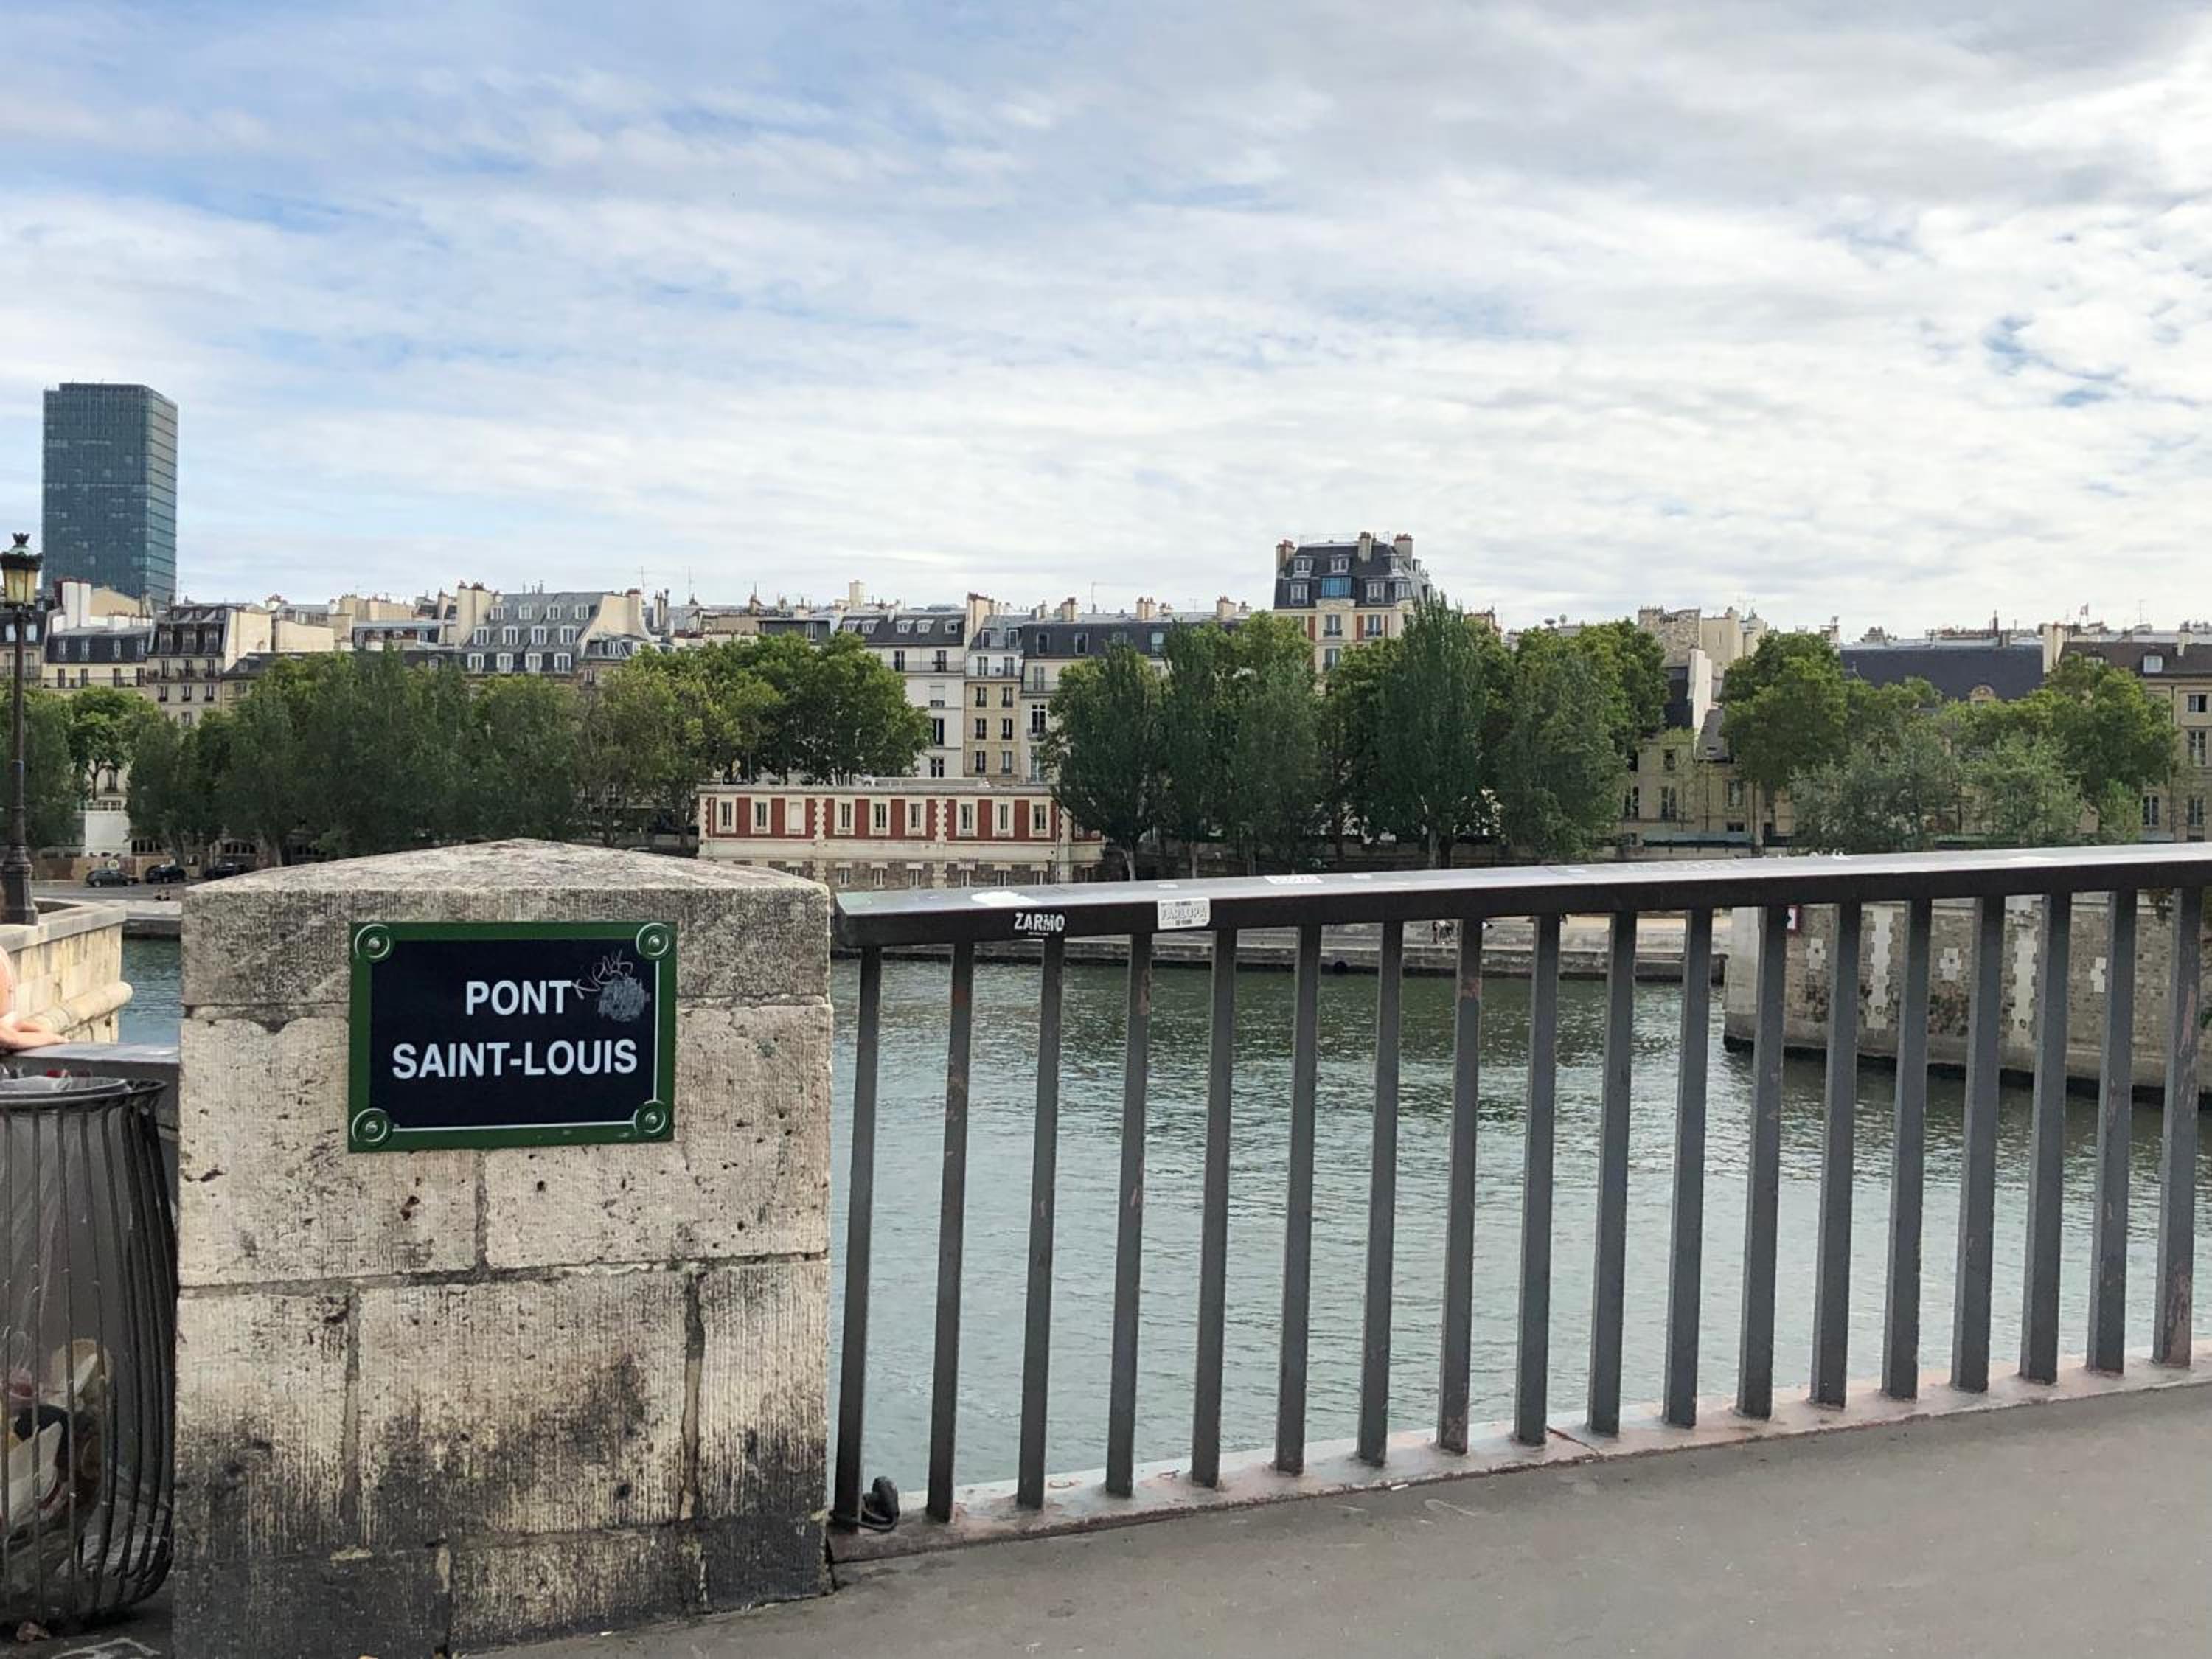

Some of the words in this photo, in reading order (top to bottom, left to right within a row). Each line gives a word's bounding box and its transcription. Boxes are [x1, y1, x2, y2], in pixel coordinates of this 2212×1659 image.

[1014, 912, 1066, 932] ZARMO
[467, 980, 571, 1015] PONT
[392, 1039, 638, 1079] SAINT-LOUIS
